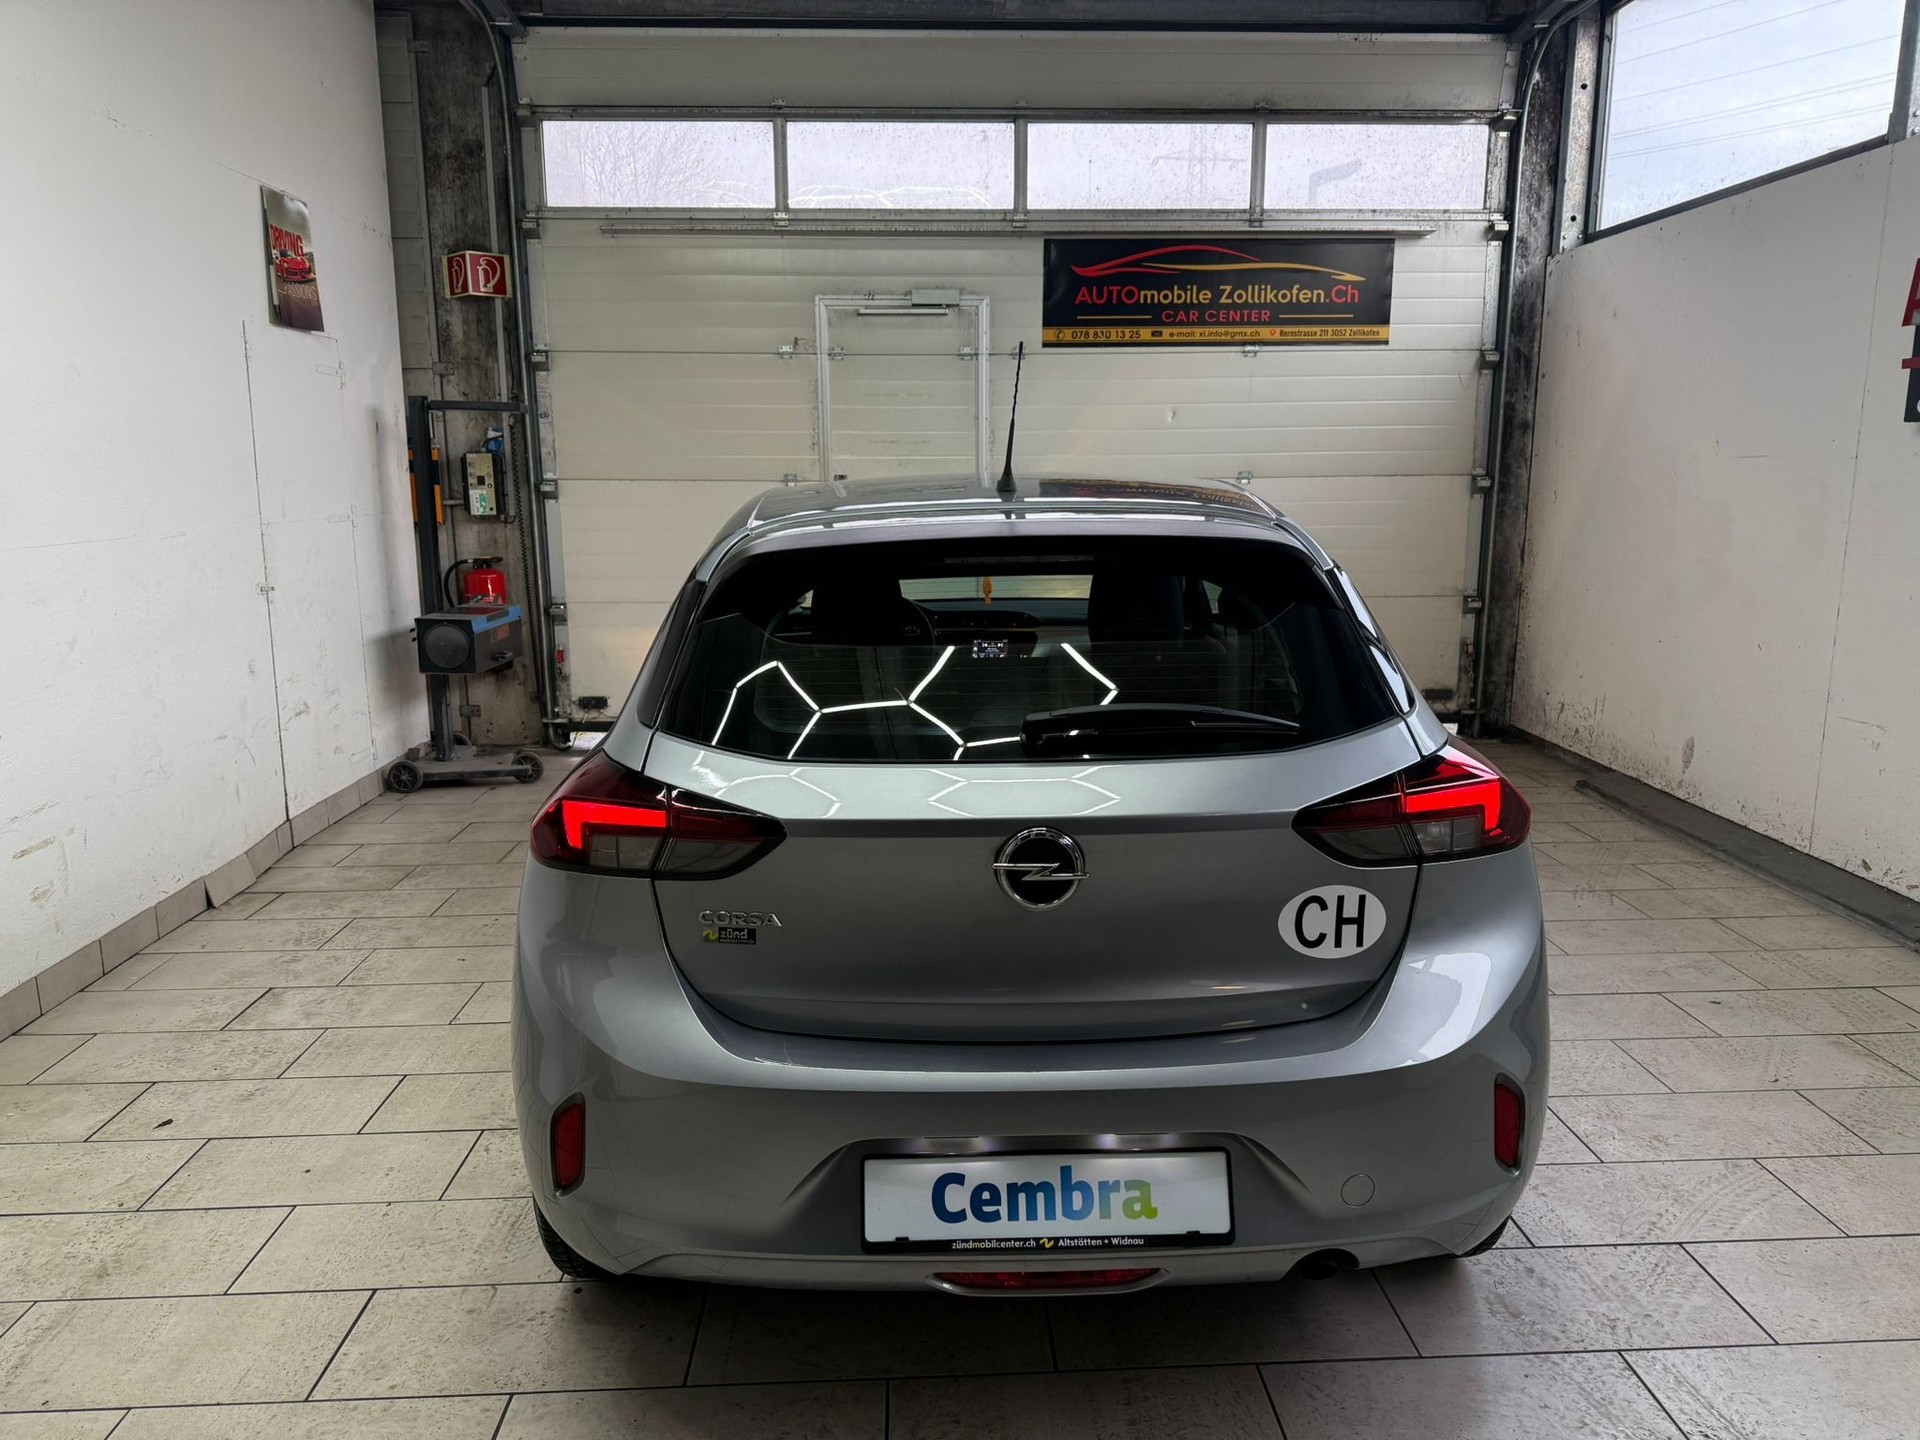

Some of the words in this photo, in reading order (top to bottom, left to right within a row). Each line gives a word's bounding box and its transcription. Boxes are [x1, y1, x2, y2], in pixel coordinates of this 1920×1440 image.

[269, 223, 304, 257] DRIVING
[1074, 285, 1212, 304] AUTOmobile
[1218, 284, 1359, 304] Zollikofen.Ch
[1161, 310, 1200, 323] CAR
[1205, 310, 1271, 322] CENTER
[1071, 330, 1090, 339] 078
[1092, 330, 1111, 339] 830
[1115, 330, 1126, 339] 13
[1129, 330, 1141, 339] 25
[1169, 330, 1196, 338] e-mail:
[1279, 329, 1317, 337] Bernstrasse
[1319, 329, 1329, 337] 211
[1330, 329, 1346, 337] 3052
[1349, 328, 1380, 337] Zollikofen
[699, 910, 782, 927] CORSA
[1294, 894, 1367, 949] CH
[720, 928, 748, 939] zünd
[931, 1165, 1158, 1224] Cembra
[952, 1240, 1036, 1250] zündmobilcenter.ch
[1058, 1237, 1102, 1247] Altstätten
[1111, 1236, 1144, 1246] Widnau
